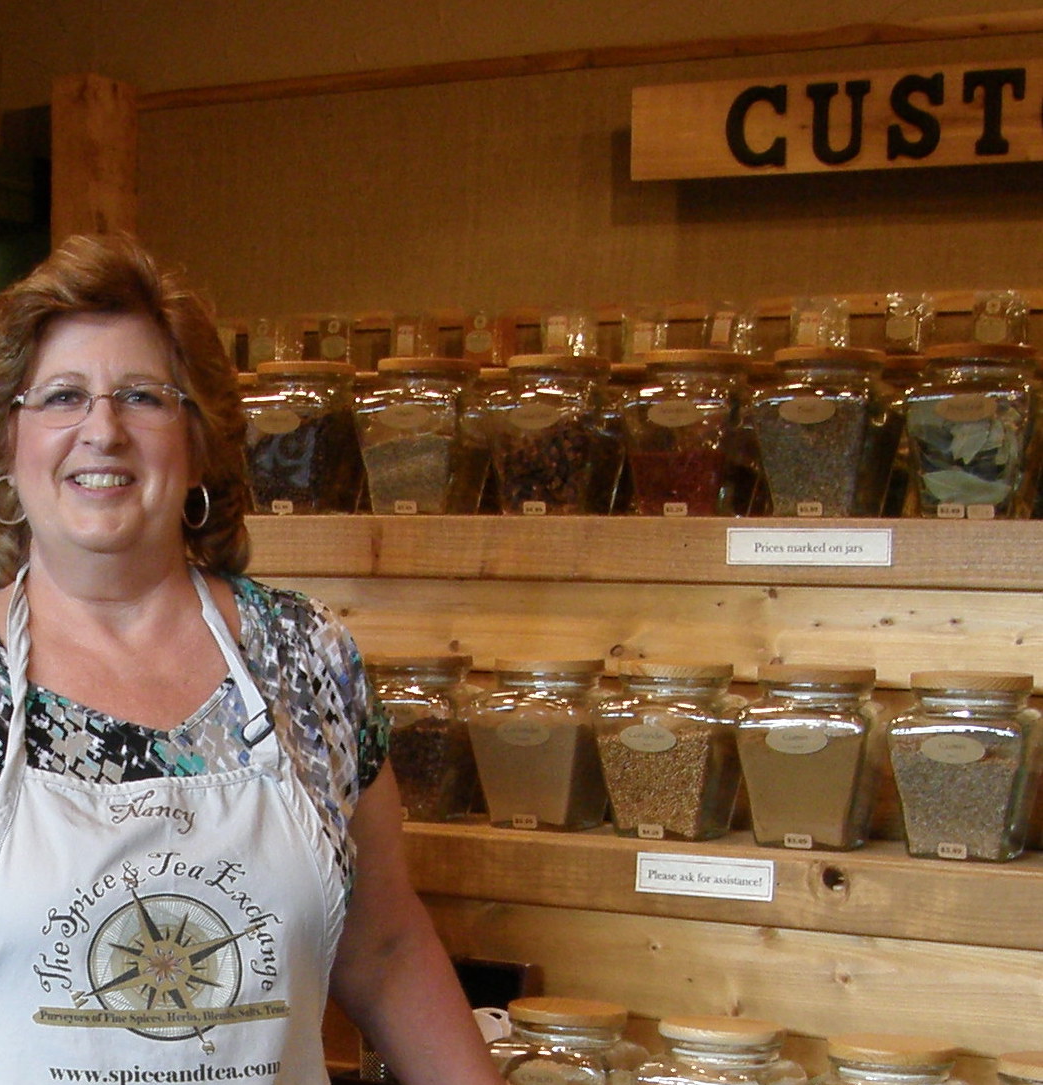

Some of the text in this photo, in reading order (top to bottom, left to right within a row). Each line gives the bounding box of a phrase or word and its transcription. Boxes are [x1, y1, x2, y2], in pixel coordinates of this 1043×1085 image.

[754, 542, 863, 555] Prices marked on jars
[109, 789, 195, 834] Nancy
[148, 851, 205, 880] Tea
[647, 869, 762, 887] Please ask for assistance!
[42, 872, 117, 937] Spice
[205, 859, 283, 992] Exchange
[33, 942, 73, 993] The
[40, 1010, 90, 1024] Purveyors
[91, 1012, 103, 1022] of
[104, 1012, 127, 1023] Fine
